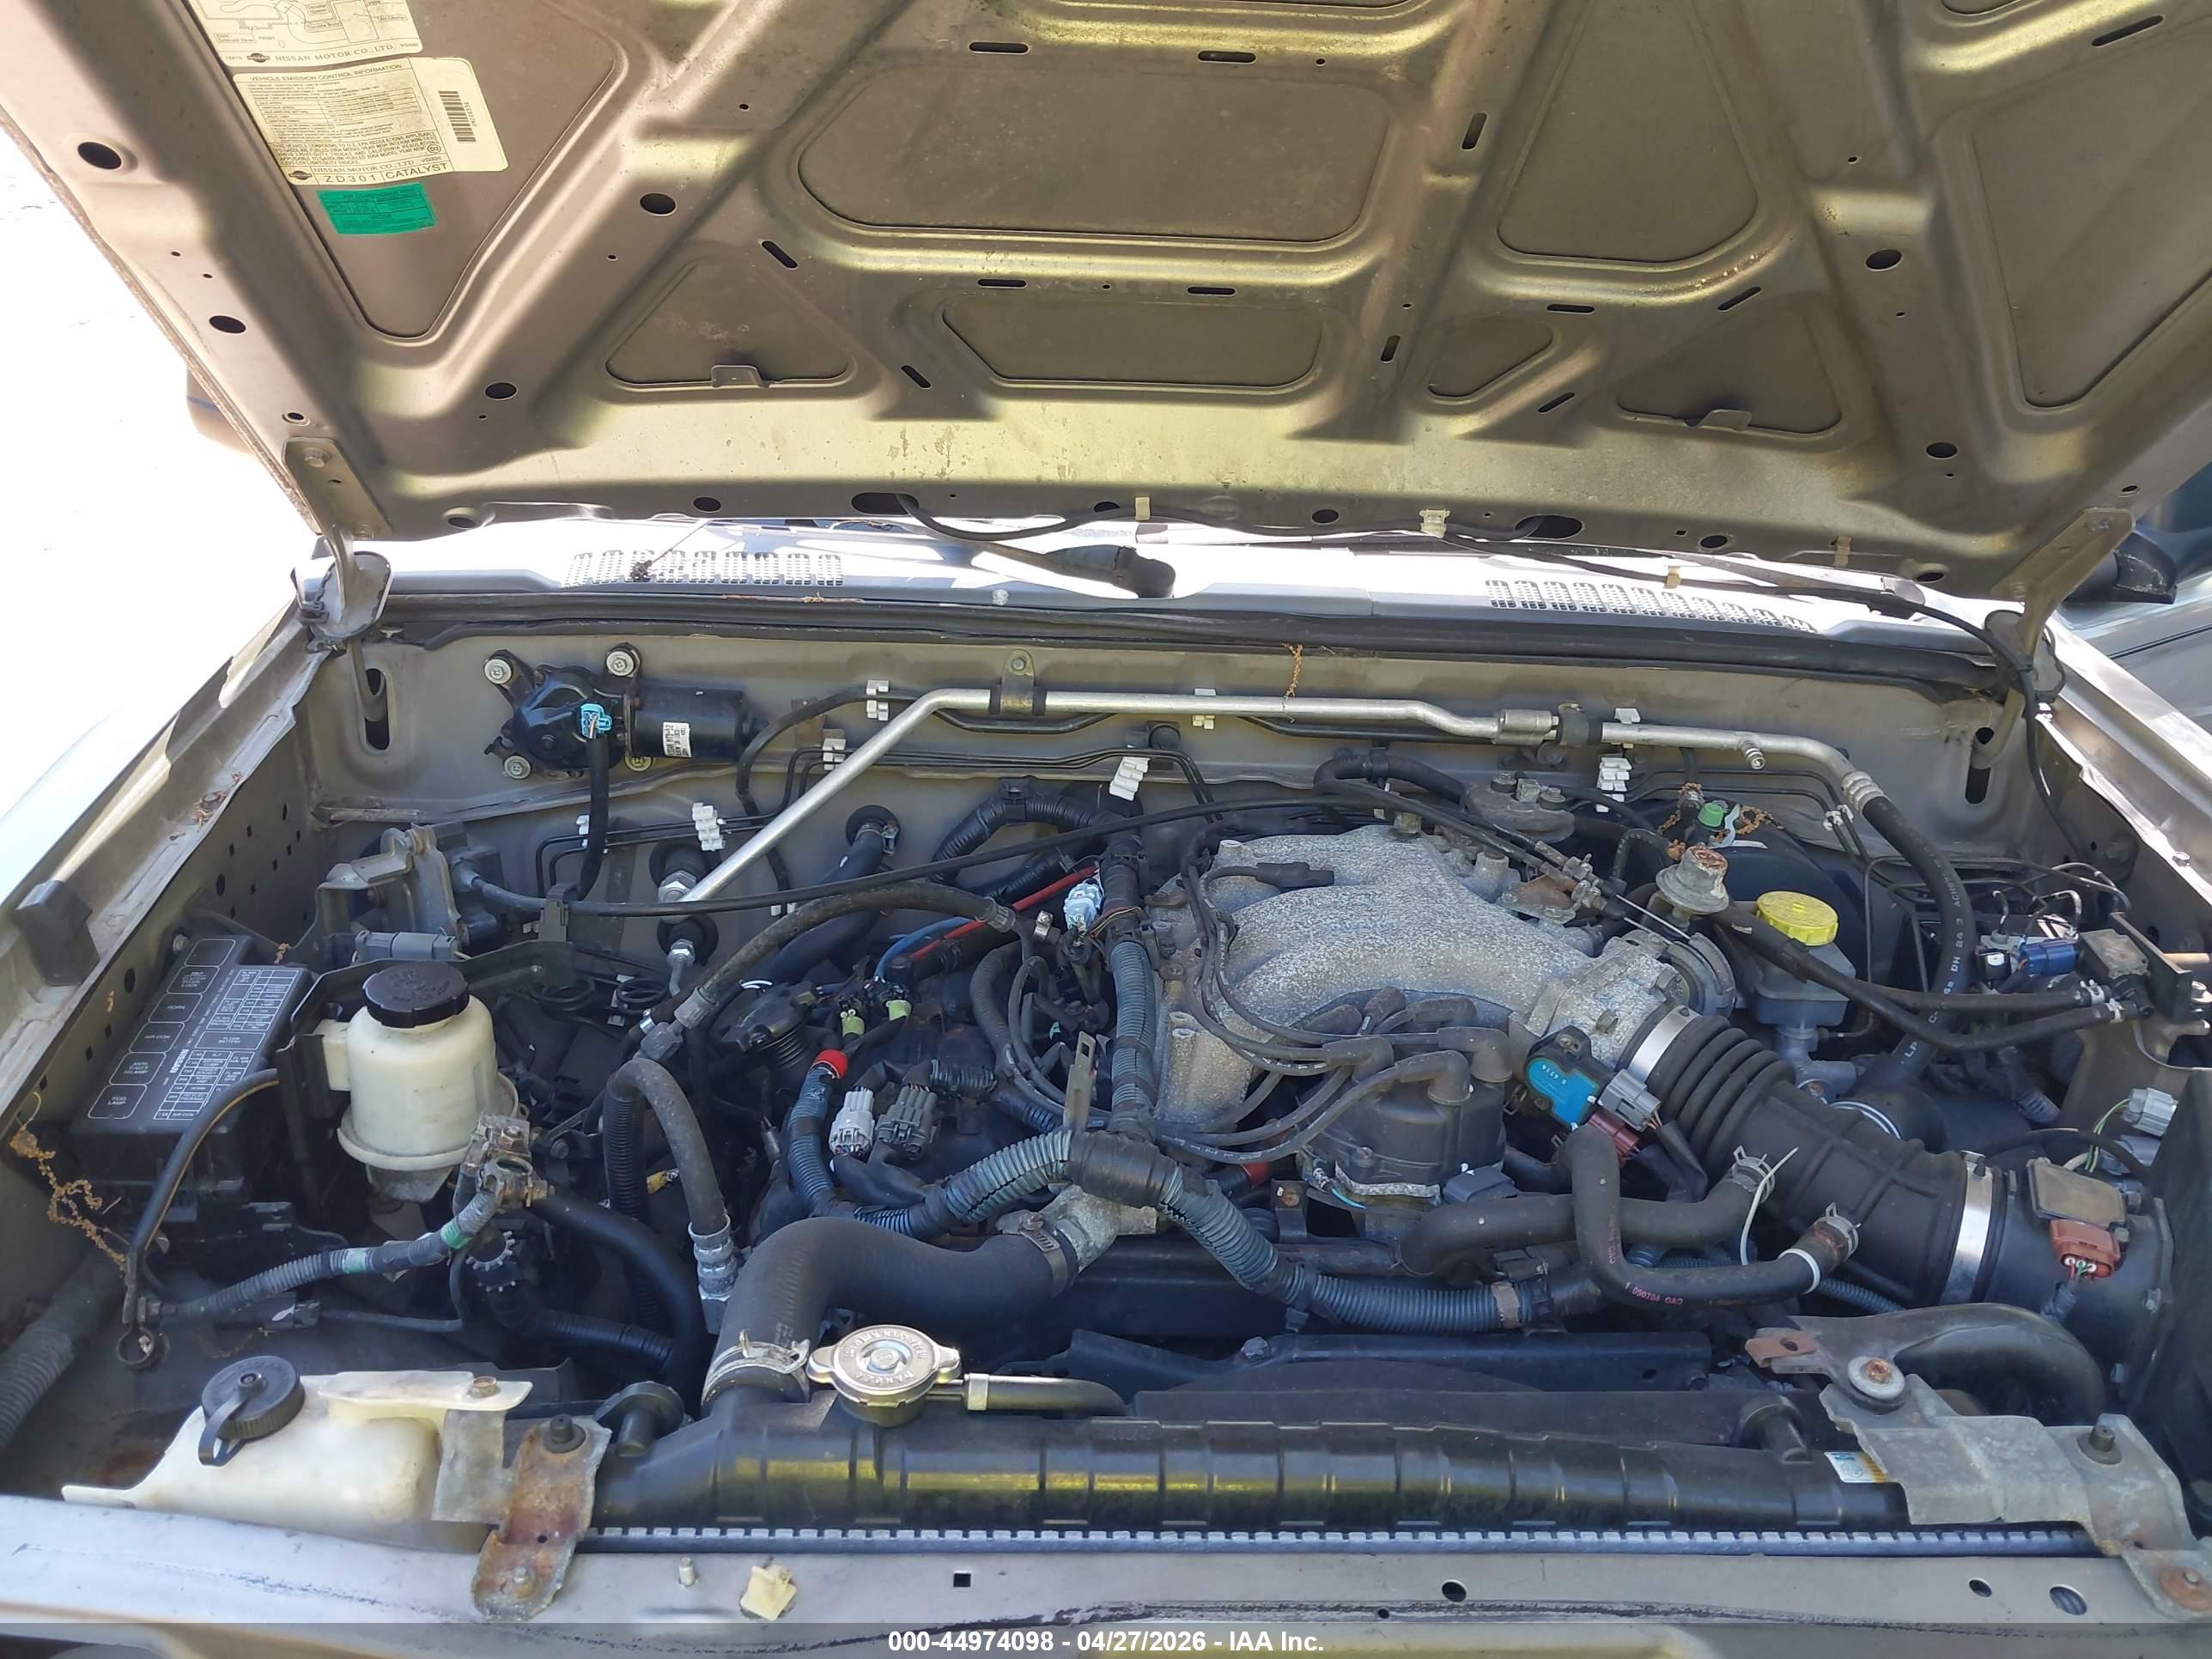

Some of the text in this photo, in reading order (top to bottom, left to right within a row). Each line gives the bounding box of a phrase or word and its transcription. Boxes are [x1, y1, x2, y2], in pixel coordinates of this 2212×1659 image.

[314, 51, 351, 60] MOTOR
[353, 64, 402, 75] INFORMATION
[385, 162, 447, 179] CATALYST
[169, 1048, 190, 1073] NISSAN
